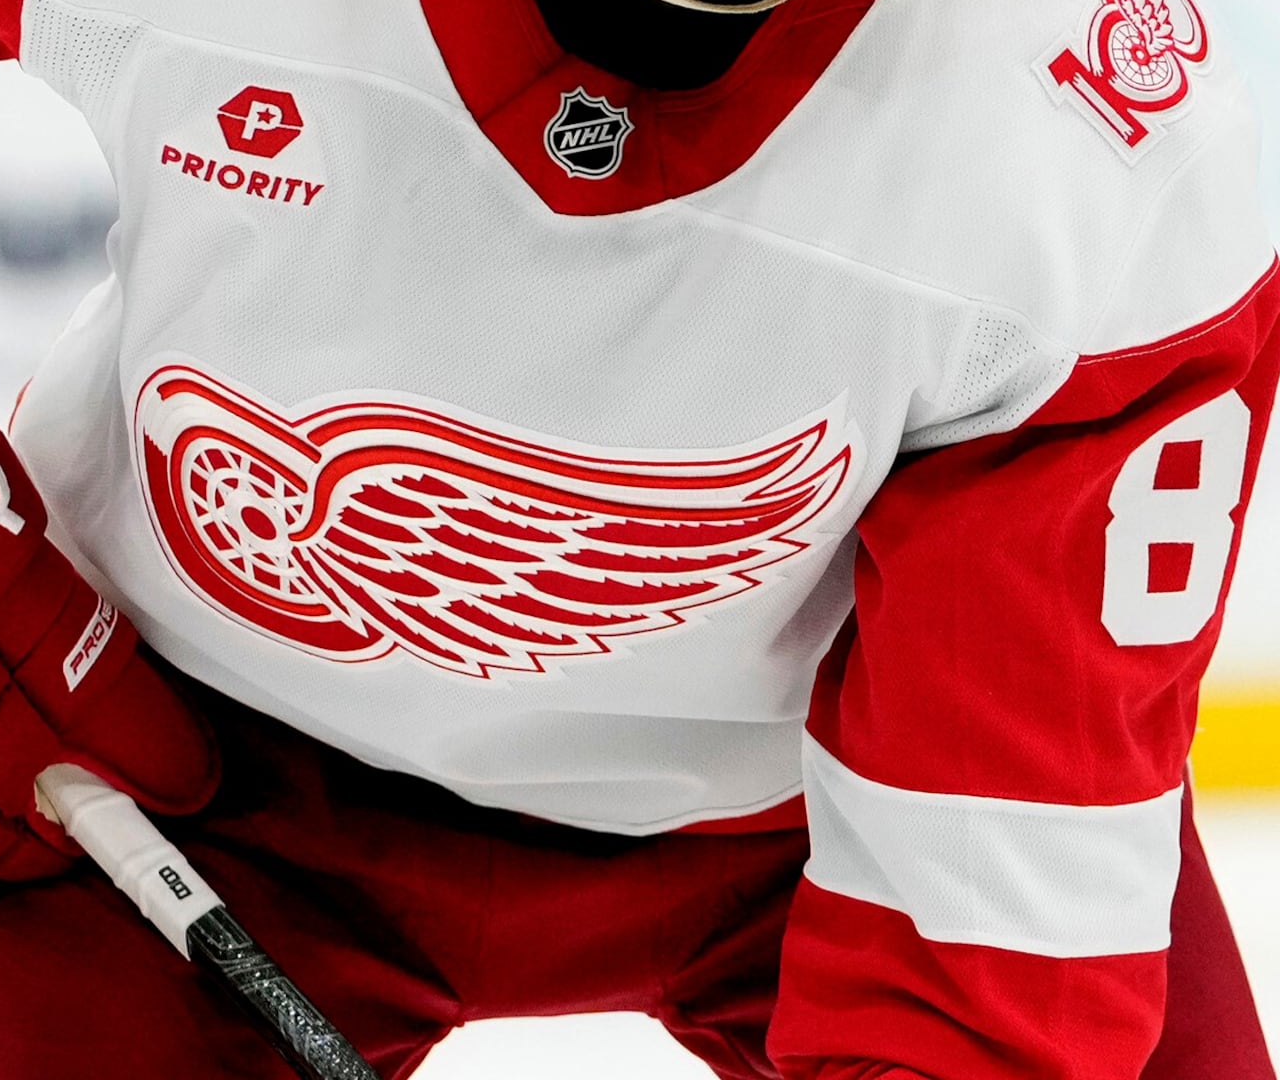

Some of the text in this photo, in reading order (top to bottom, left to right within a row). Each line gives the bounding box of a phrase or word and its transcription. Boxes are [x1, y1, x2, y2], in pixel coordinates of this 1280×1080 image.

[559, 123, 614, 150] NHL
[161, 144, 325, 206] PRIORITY
[70, 621, 106, 676] PRO
[158, 865, 193, 900] 88
